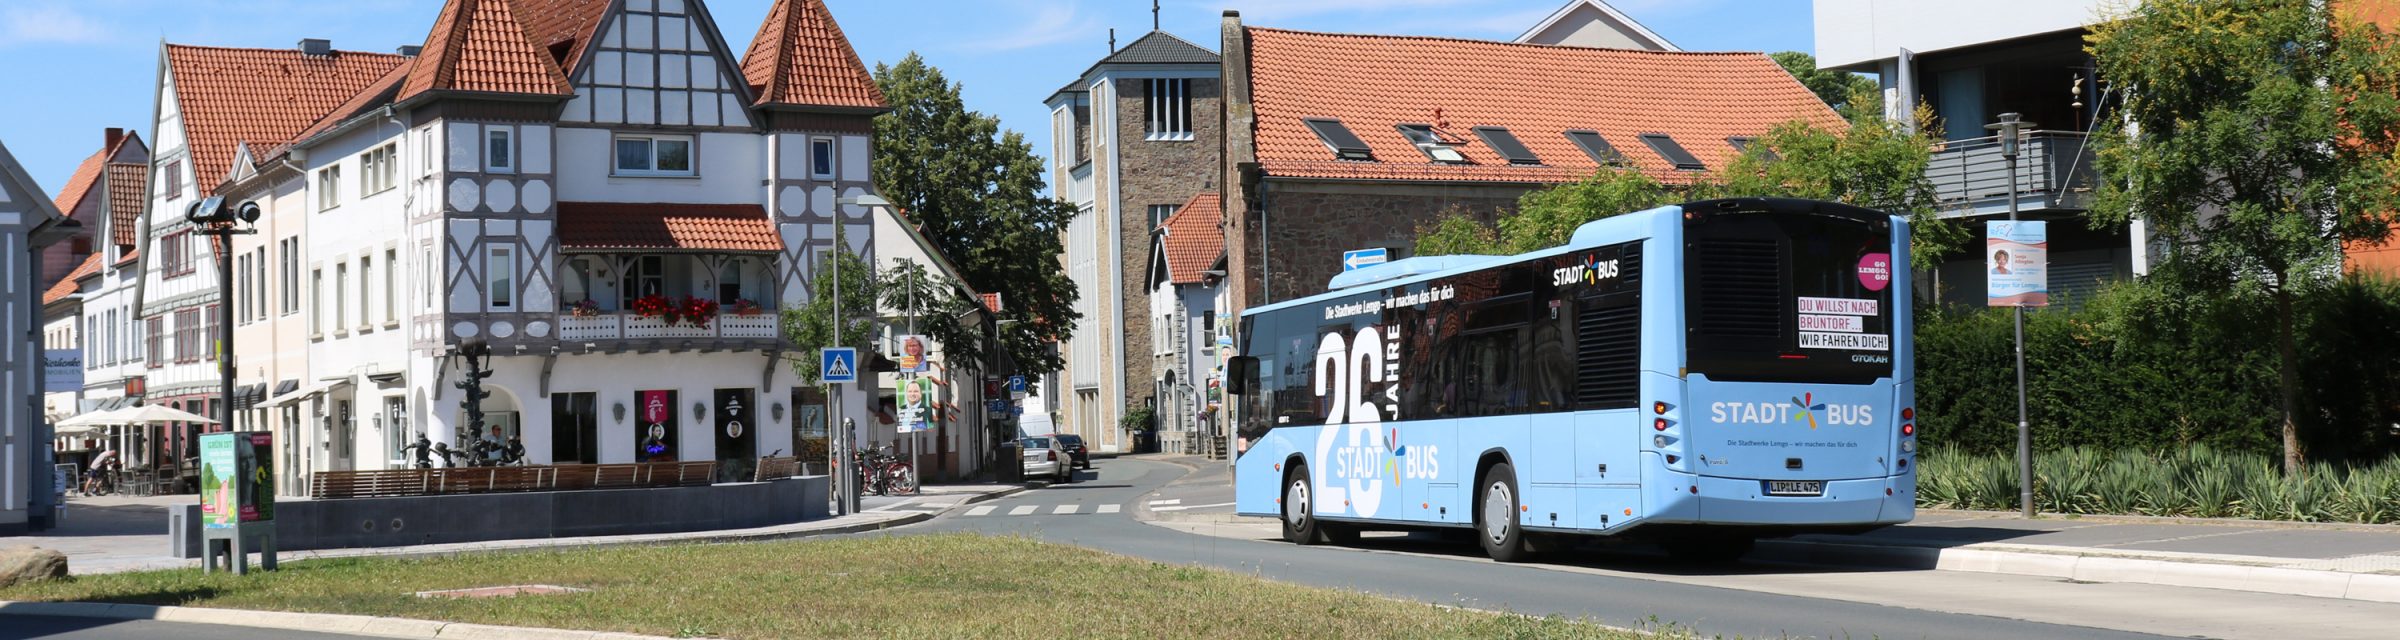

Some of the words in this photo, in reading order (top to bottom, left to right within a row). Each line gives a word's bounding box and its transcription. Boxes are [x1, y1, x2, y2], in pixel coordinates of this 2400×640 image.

[1553, 264, 1585, 287] STADT
[1598, 258, 1619, 280] BUS
[1325, 306, 1335, 320] Die
[1335, 301, 1363, 318] Stadtwerke
[1363, 299, 1381, 315] Lemgo
[1385, 294, 1395, 309] wir
[1396, 291, 1419, 308] machen
[1419, 289, 1430, 304] das
[1430, 286, 1441, 302] für
[1441, 284, 1455, 300] dich
[1800, 299, 1813, 312] DU
[1815, 299, 1850, 314] WILLST
[1851, 301, 1877, 314] NACH
[1800, 333, 1820, 346] WIR
[1822, 334, 1859, 348] FAHREN
[1861, 335, 1888, 349] DICH!
[1012, 377, 1022, 390] P
[1386, 323, 1401, 421] JAHRE
[1315, 326, 1383, 518] 26
[1711, 402, 1791, 424] STADT
[1827, 404, 1873, 426] BUS
[1727, 439, 1737, 447] Die
[1738, 439, 1769, 447] Stadtwerke
[1770, 440, 1789, 449] Lemgo
[1336, 445, 1384, 479] STADT
[1406, 445, 1439, 480] BUS
[1770, 481, 1786, 493] LIP
[1791, 481, 1801, 493] LE
[1803, 482, 1820, 493] 475
